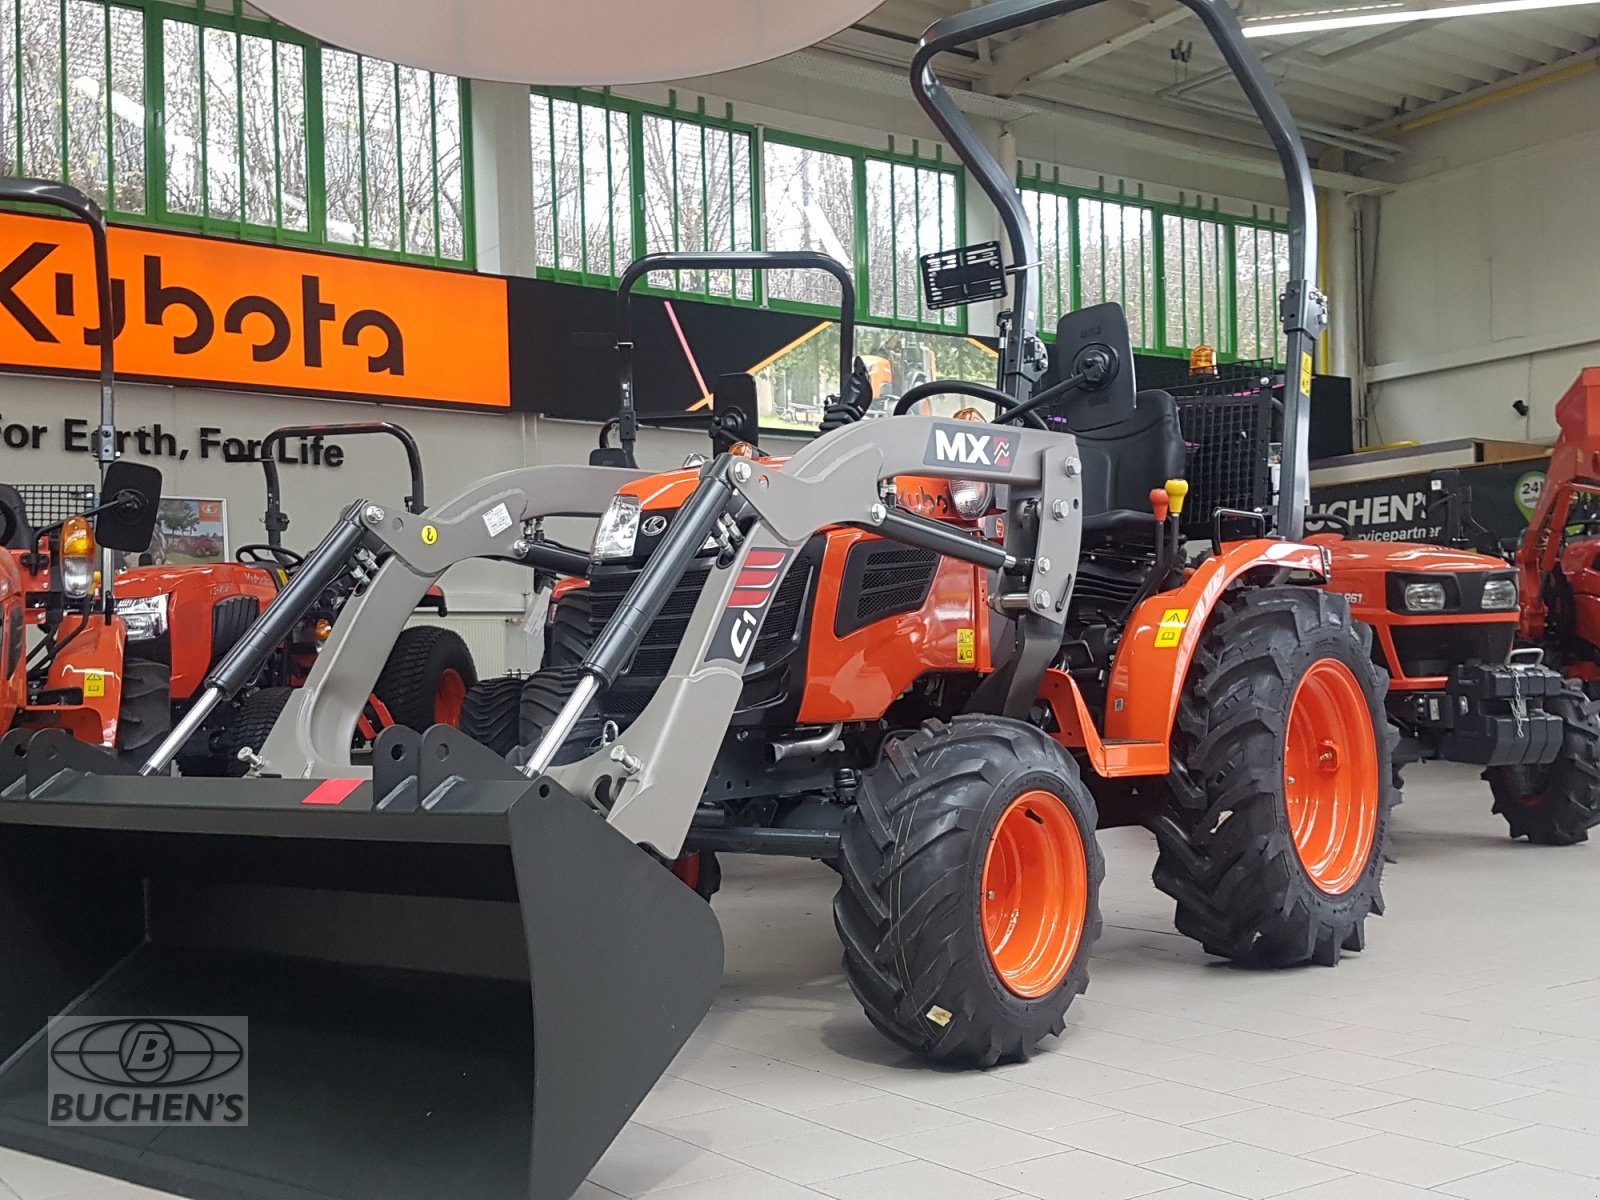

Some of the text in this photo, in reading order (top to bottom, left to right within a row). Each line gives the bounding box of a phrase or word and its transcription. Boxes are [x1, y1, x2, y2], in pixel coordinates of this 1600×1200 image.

[0, 242, 404, 376] Kubota
[0, 413, 344, 467] or Erth, For Life
[935, 429, 991, 465] MX
